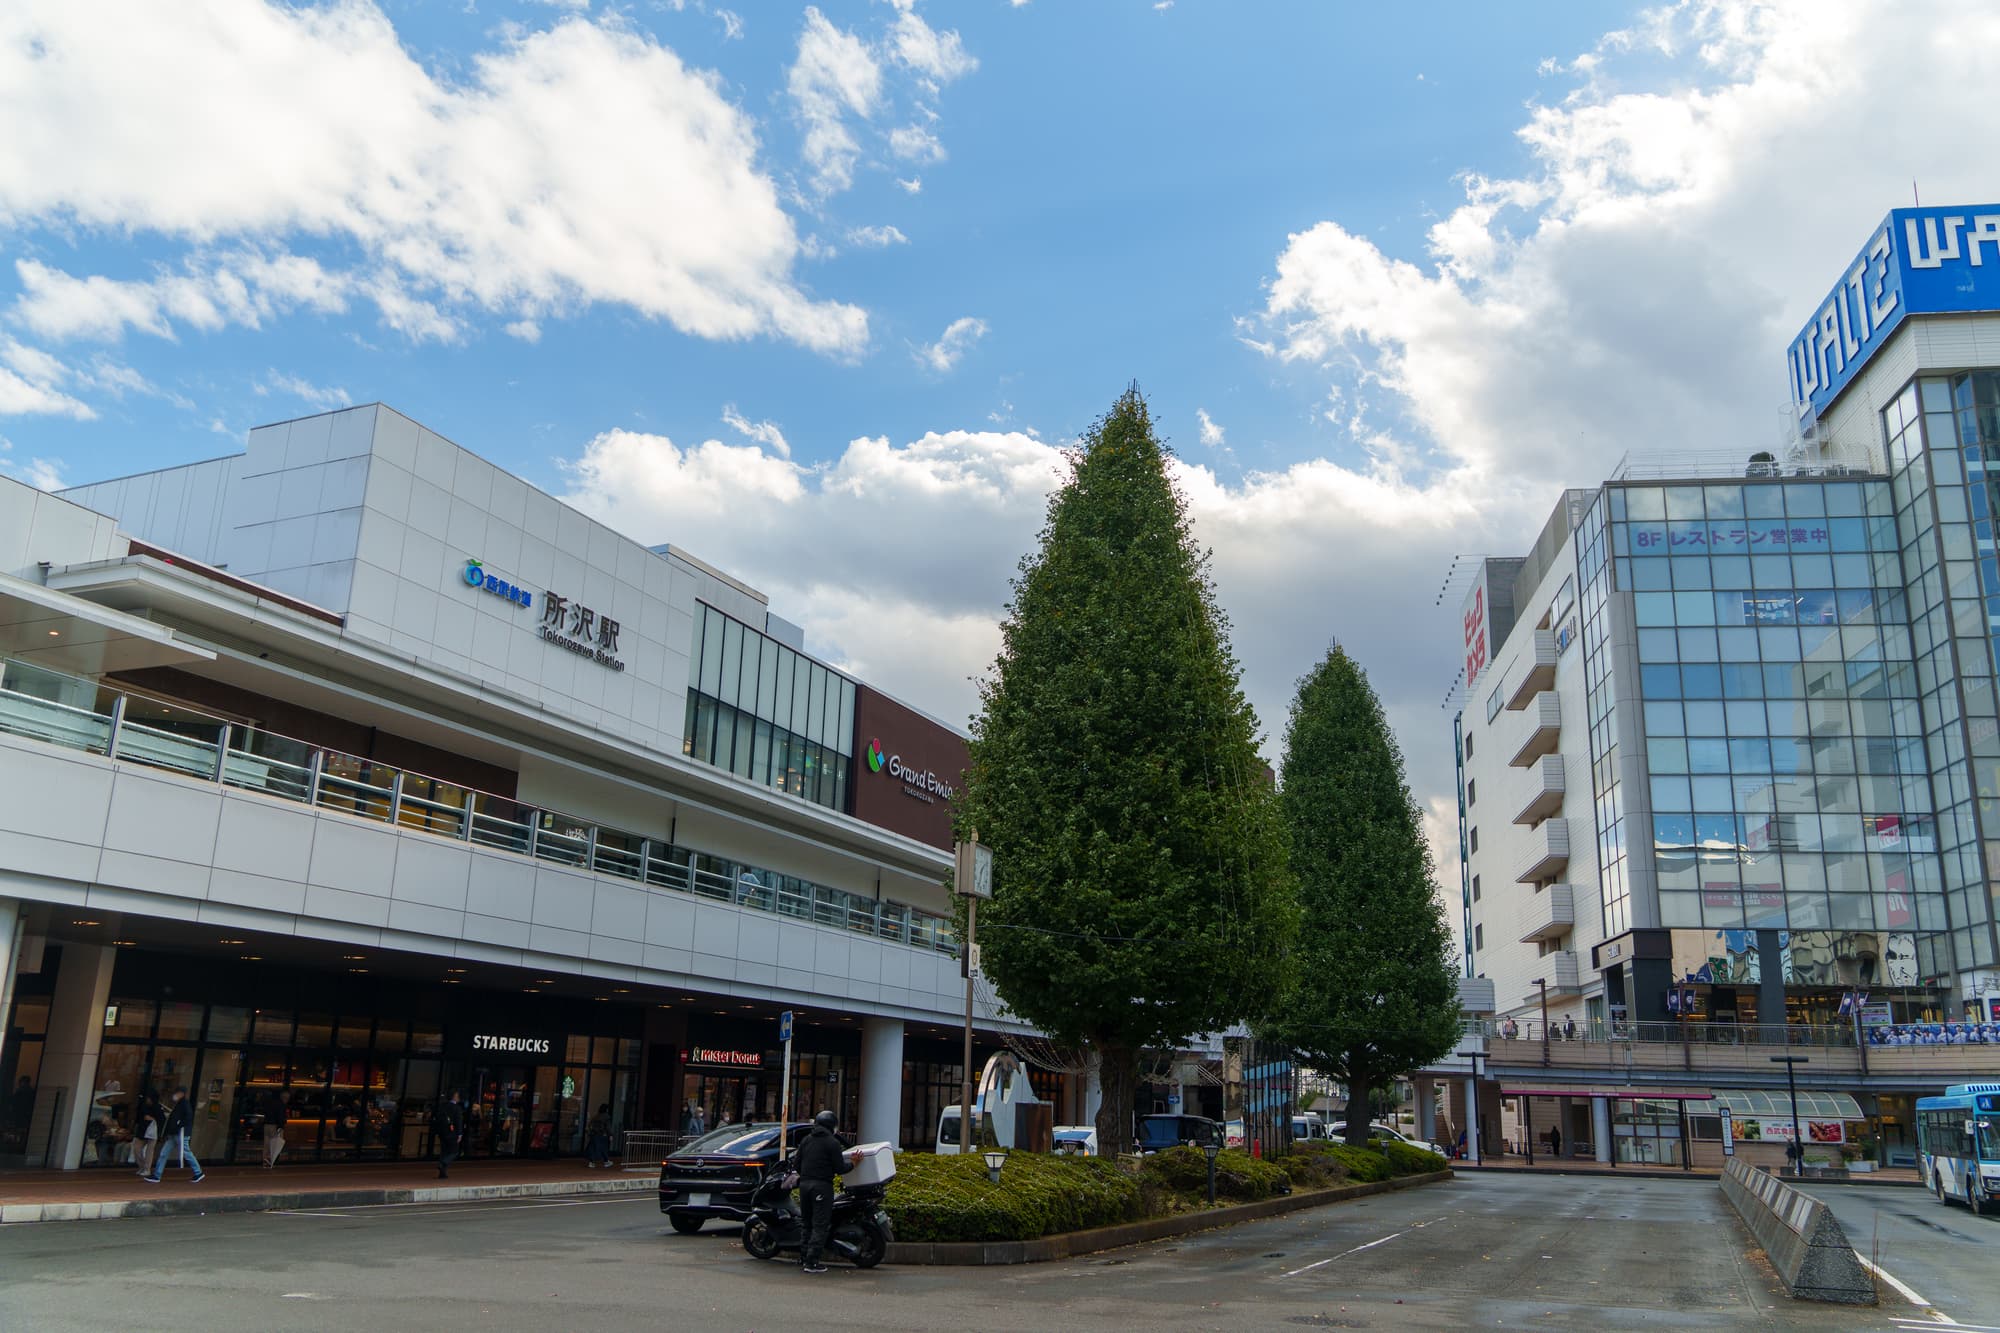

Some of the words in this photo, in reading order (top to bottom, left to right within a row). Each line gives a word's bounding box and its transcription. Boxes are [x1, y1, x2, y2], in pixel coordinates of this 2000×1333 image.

[1637, 531, 1661, 547] 8F
[1671, 528, 1827, 546] レストラン営業中
[543, 590, 620, 652] 所沢駅
[542, 625, 594, 659] Tokorozawa
[596, 649, 625, 672] Station
[889, 755, 926, 789] Grand
[473, 1034, 550, 1053] STARBUCKS
